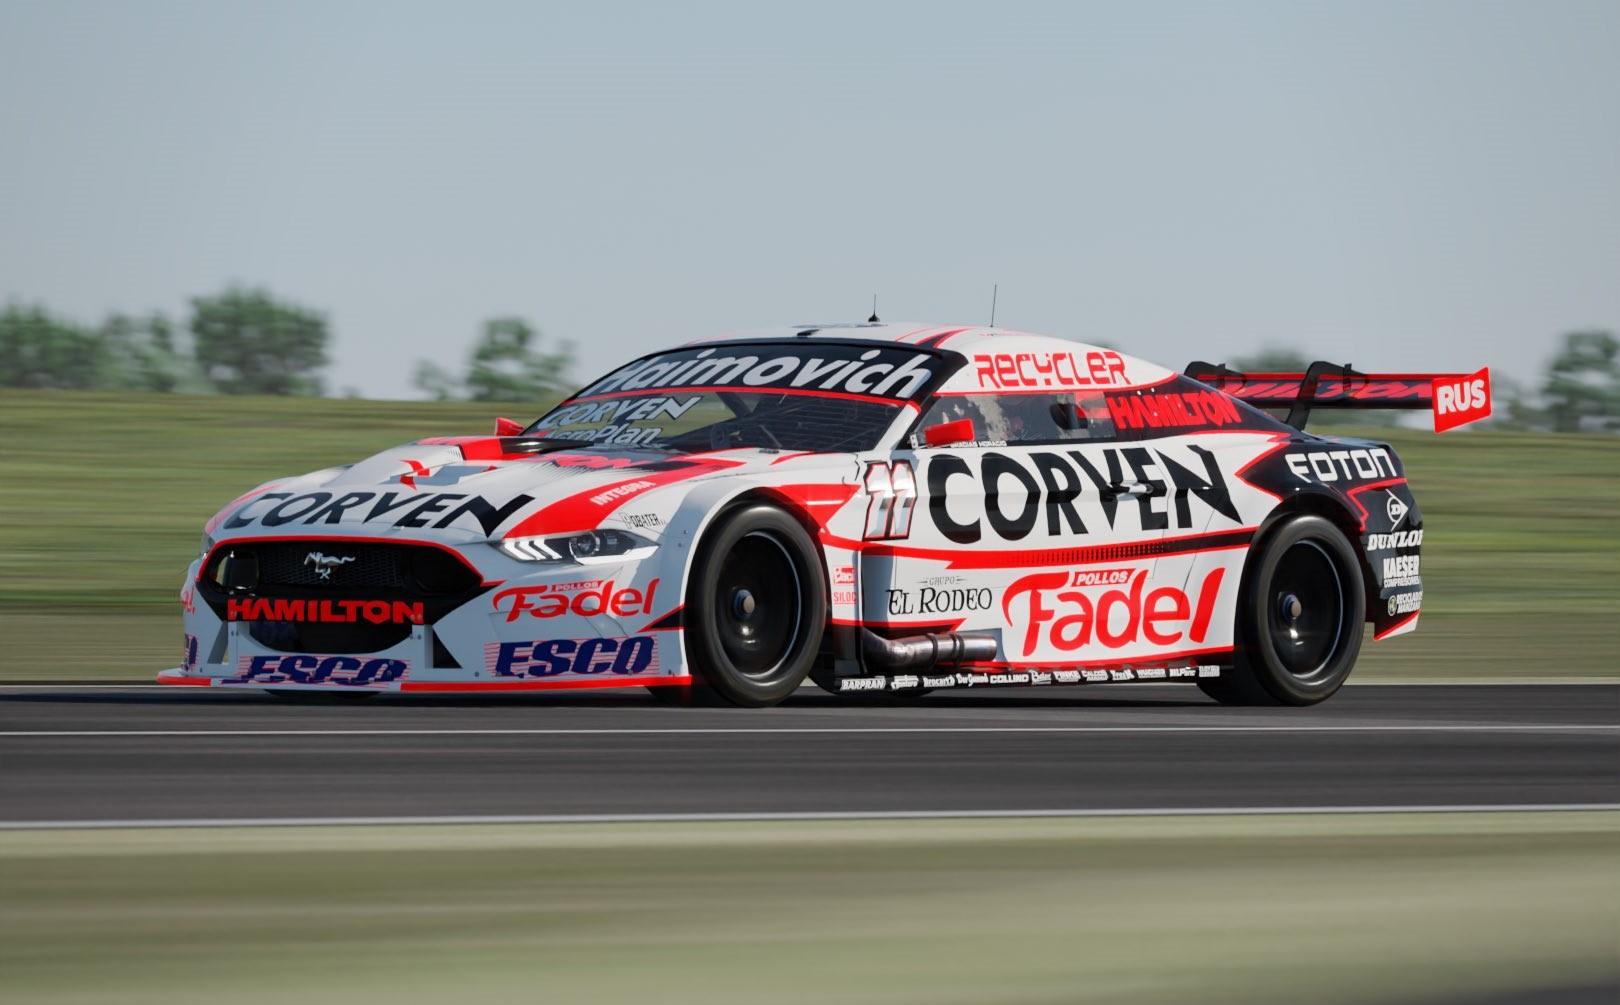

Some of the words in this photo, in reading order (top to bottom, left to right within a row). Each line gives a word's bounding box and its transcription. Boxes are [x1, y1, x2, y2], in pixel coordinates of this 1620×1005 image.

[579, 348, 931, 398] Haimovich
[974, 351, 1131, 389] RECYCLER
[537, 396, 702, 429] CORVEN
[1107, 391, 1242, 430] HAMILTON
[1436, 379, 1487, 415] RUS
[1285, 448, 1397, 485] FOTON
[863, 459, 917, 541] 11
[927, 445, 1244, 544] CORVEN
[223, 492, 536, 538] CORVEN
[555, 581, 600, 593] POLLOS
[1076, 570, 1129, 586] POLLOS
[227, 598, 424, 625] HAMILTON
[493, 578, 660, 622] Fadel
[919, 587, 993, 615] RODEO
[1002, 568, 1226, 657] Fadel
[234, 655, 407, 685] ESCO
[495, 636, 655, 678] ESCO
